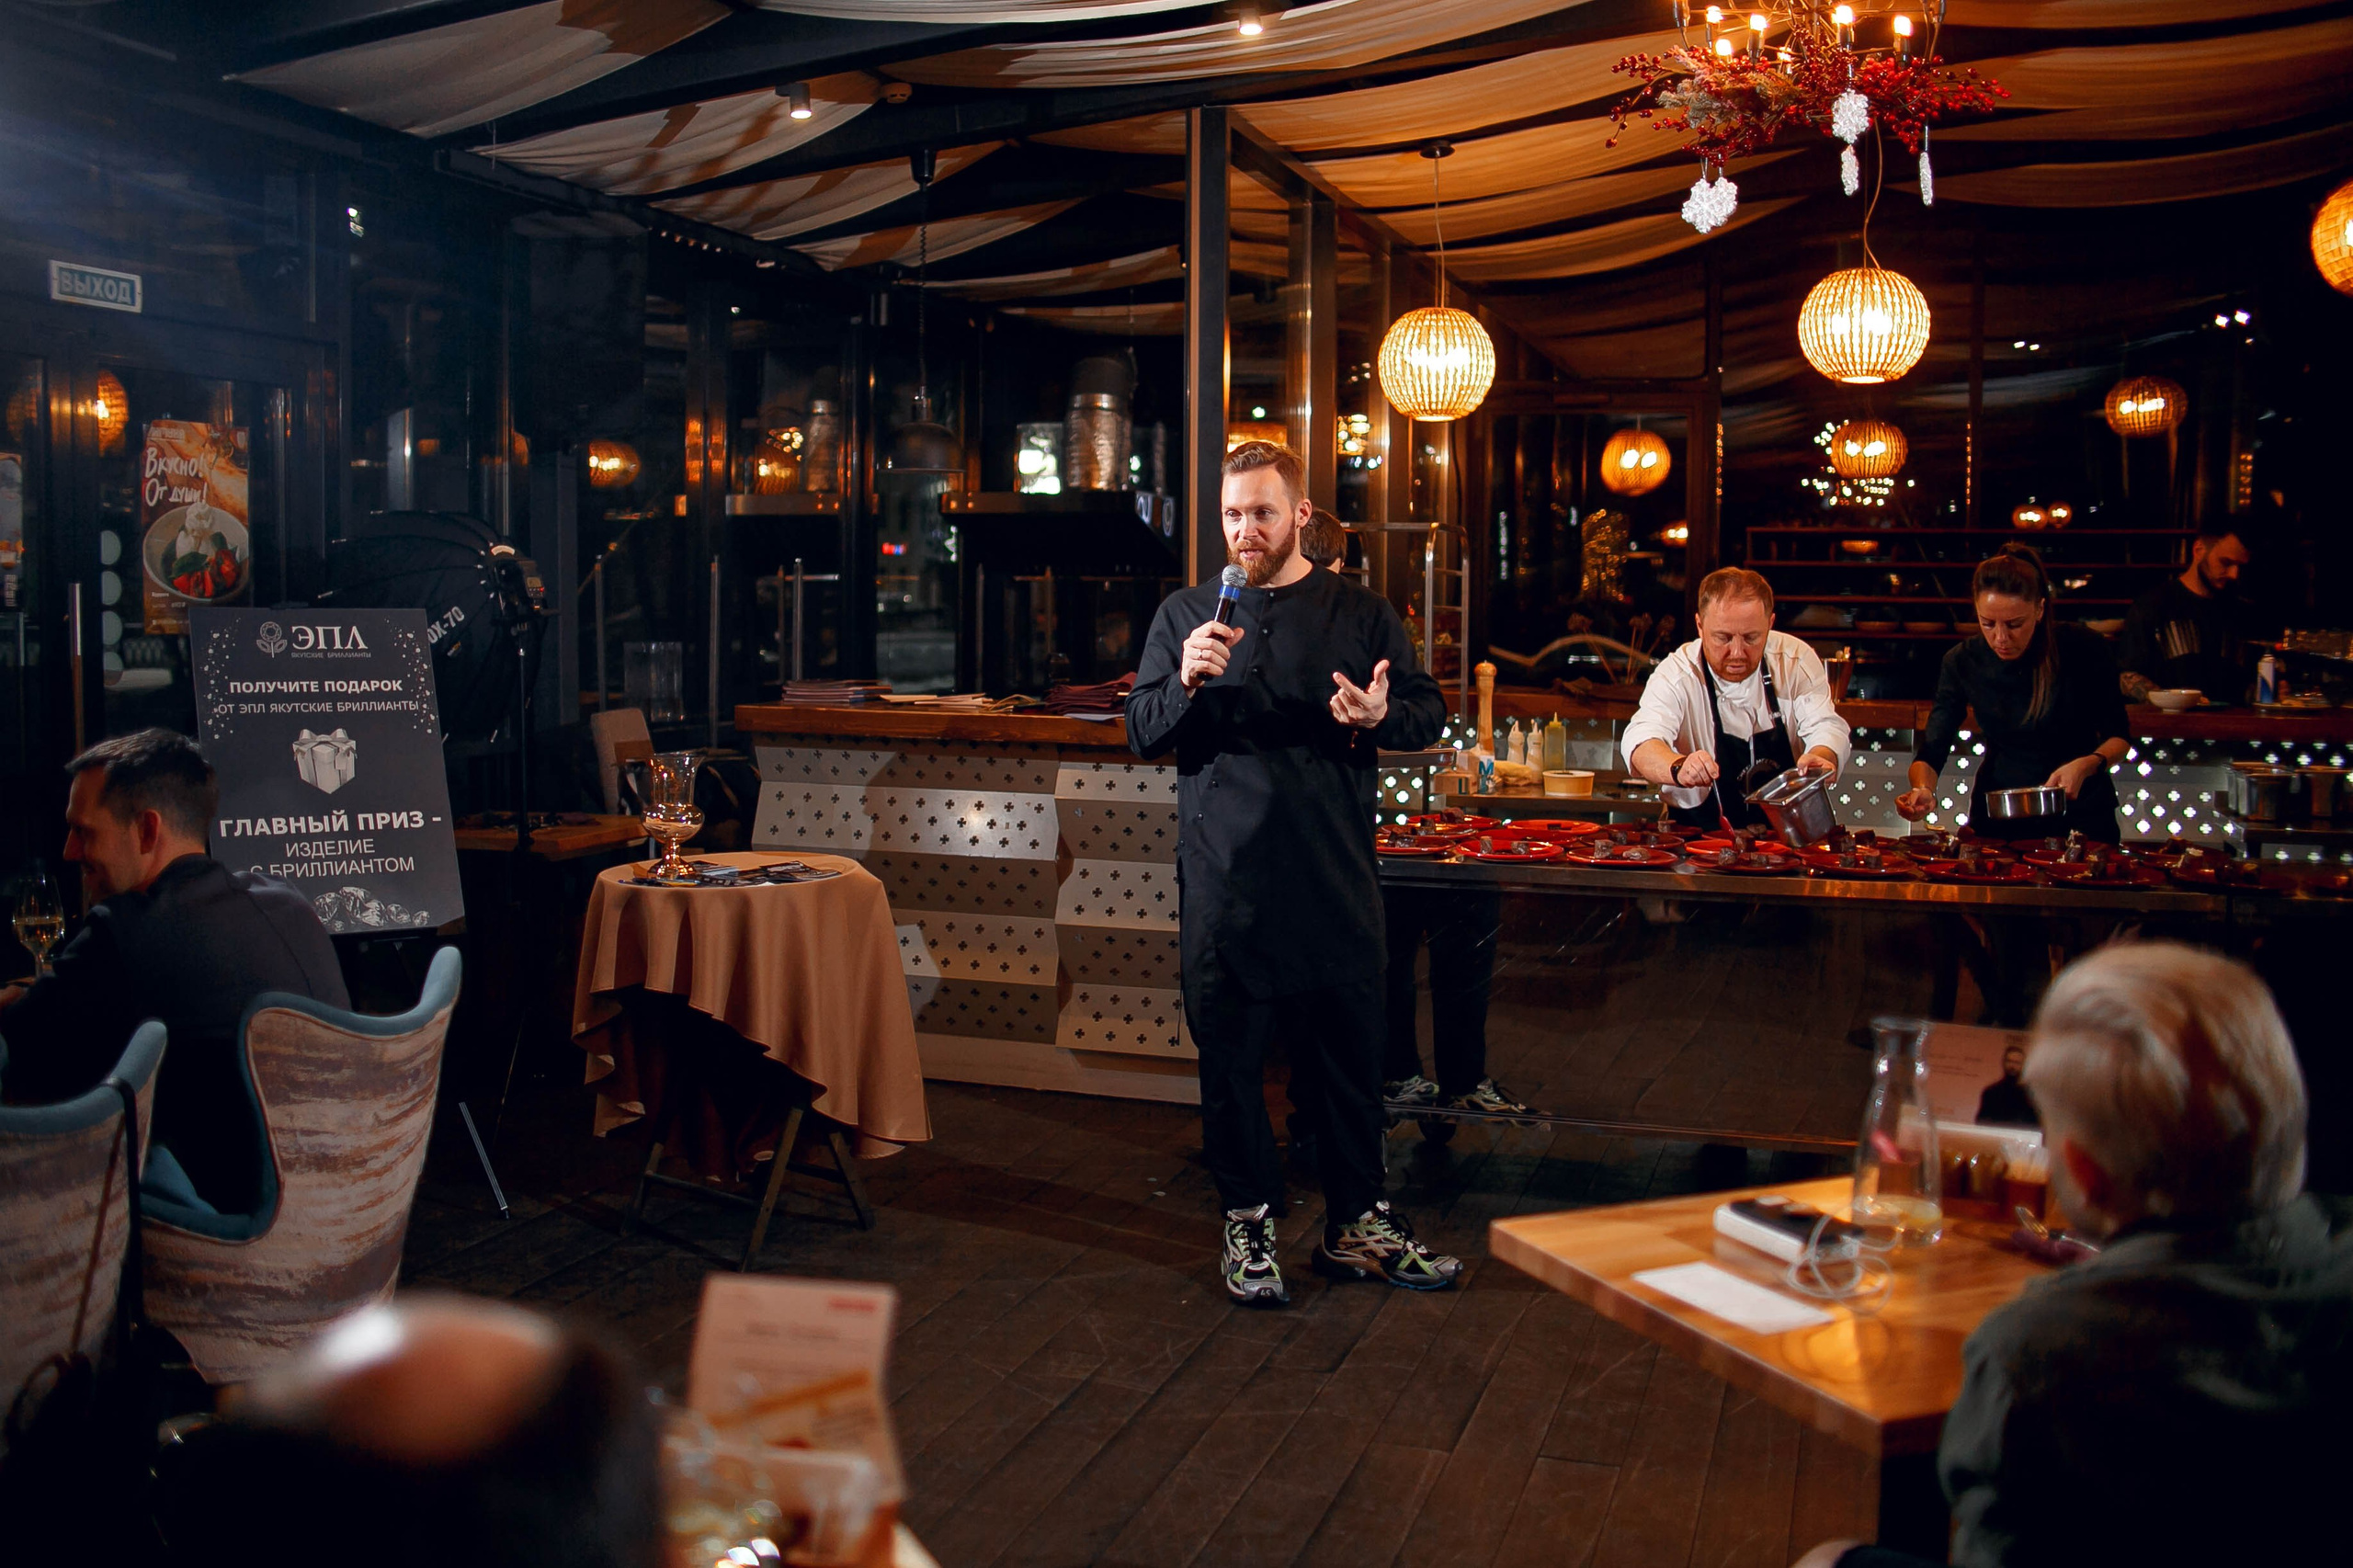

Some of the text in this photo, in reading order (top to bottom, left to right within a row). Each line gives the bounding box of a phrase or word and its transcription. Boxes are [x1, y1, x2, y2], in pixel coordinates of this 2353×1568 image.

[61, 271, 131, 304] ВЫХОД
[145, 478, 167, 506] От
[291, 625, 369, 650] ЭПЛ
[230, 680, 403, 694] ПОЛУЧИТЕ ПОДАРОК
[218, 700, 419, 714] ОТ ЭПЛ ЯКУТСКИЕ БРИЛЛИАНТЫ
[220, 809, 349, 837] ГЛАВНЫЙ
[358, 811, 425, 831] ПРИЗ
[286, 838, 375, 858] ИЗДЕЛИЕ
[270, 857, 415, 878] БРИЛЛИАНТОМ
